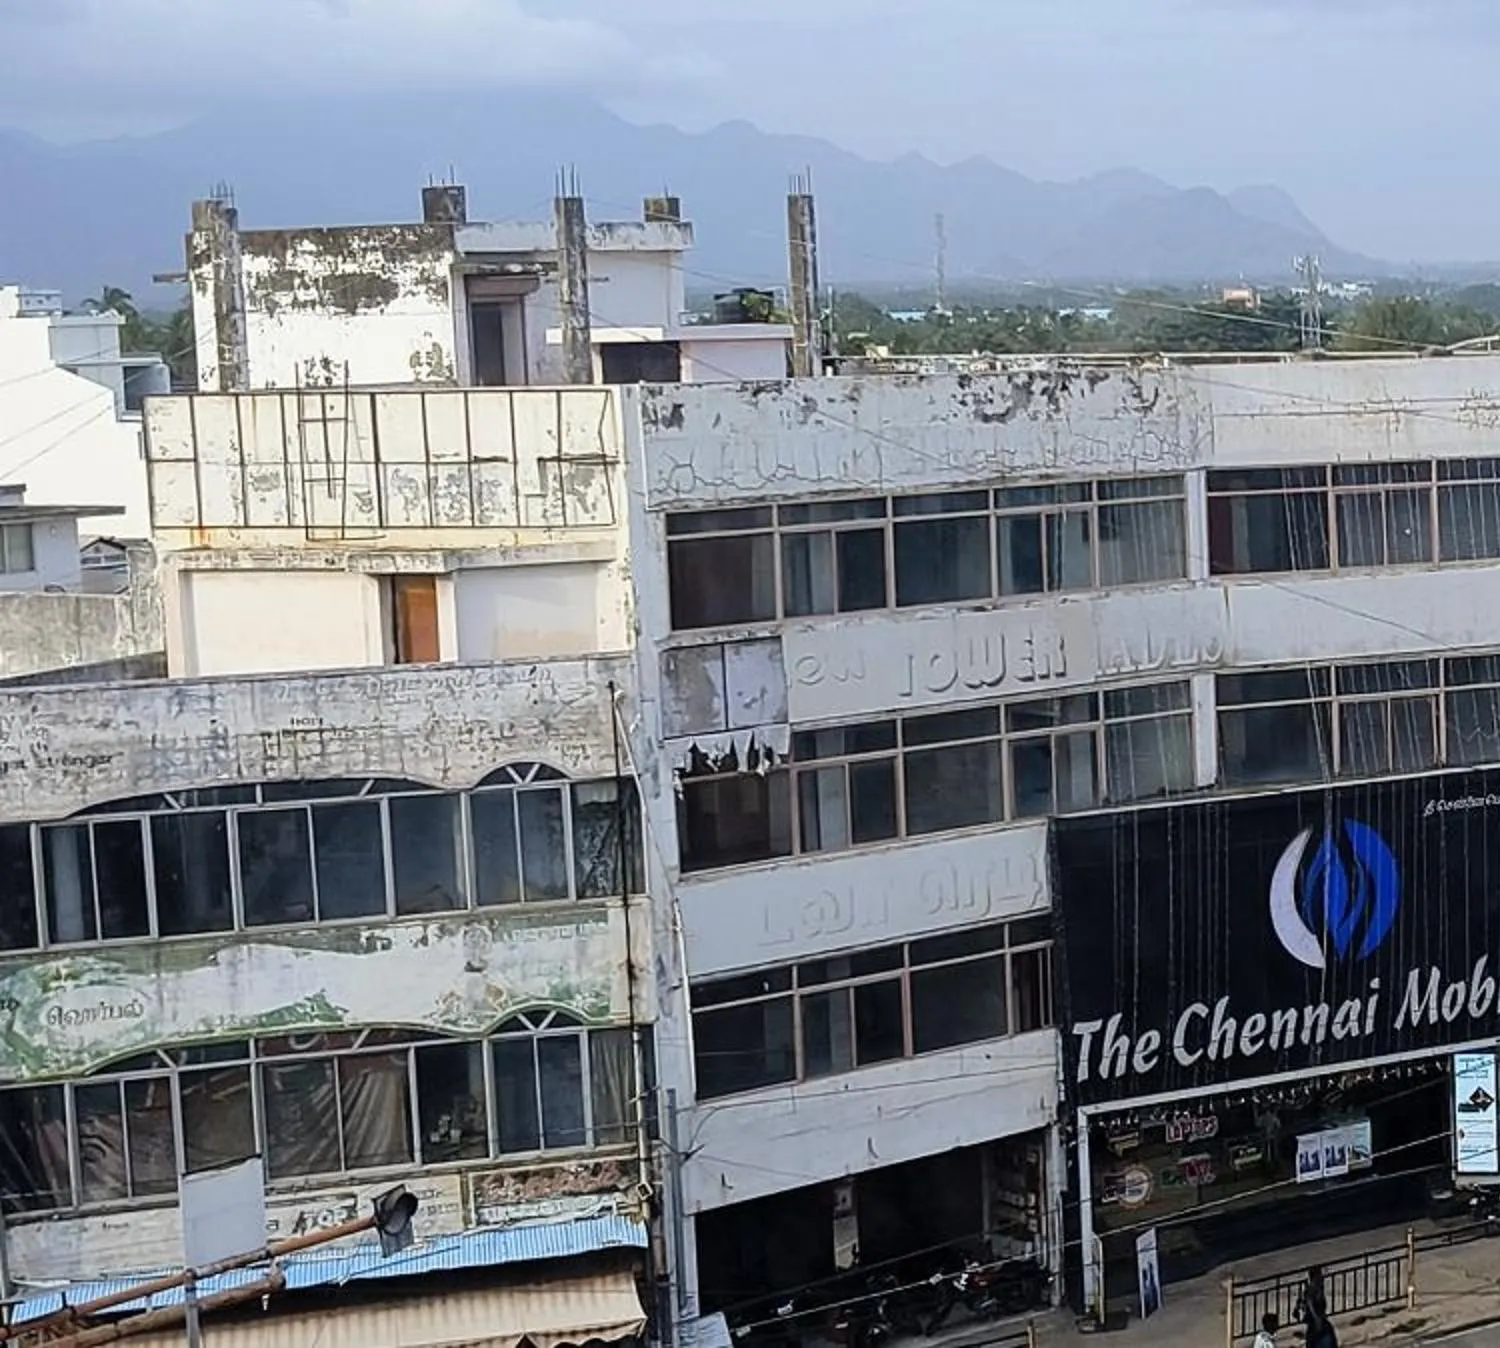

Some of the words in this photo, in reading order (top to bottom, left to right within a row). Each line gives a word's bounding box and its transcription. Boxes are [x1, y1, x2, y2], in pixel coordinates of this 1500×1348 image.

[900, 622, 1067, 697] TOWER
[1072, 1012, 1161, 1084] The
[1172, 976, 1381, 1067] Chennai
